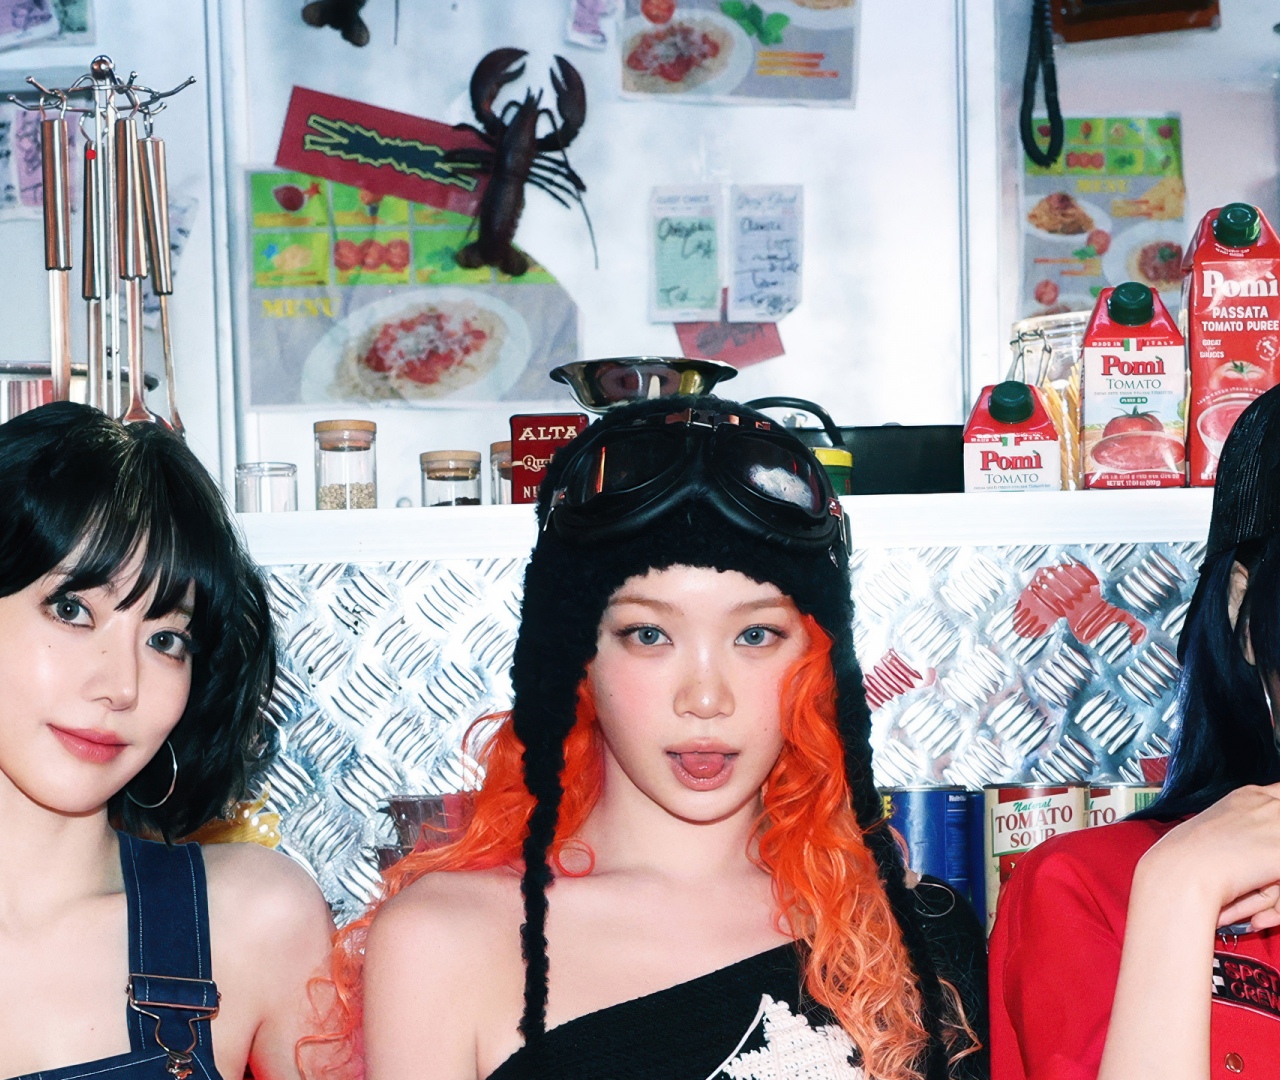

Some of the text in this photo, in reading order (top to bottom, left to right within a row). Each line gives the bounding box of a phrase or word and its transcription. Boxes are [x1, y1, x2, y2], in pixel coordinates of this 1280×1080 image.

[1212, 306, 1268, 319] PASSATA
[1202, 321, 1279, 332] TOMATO PUREE
[1105, 379, 1162, 389] TOMATO
[518, 426, 578, 441] ALTA
[984, 473, 1039, 484] TOMATO
[995, 805, 1073, 834] TOMATO
[1224, 961, 1278, 992] SPGT
